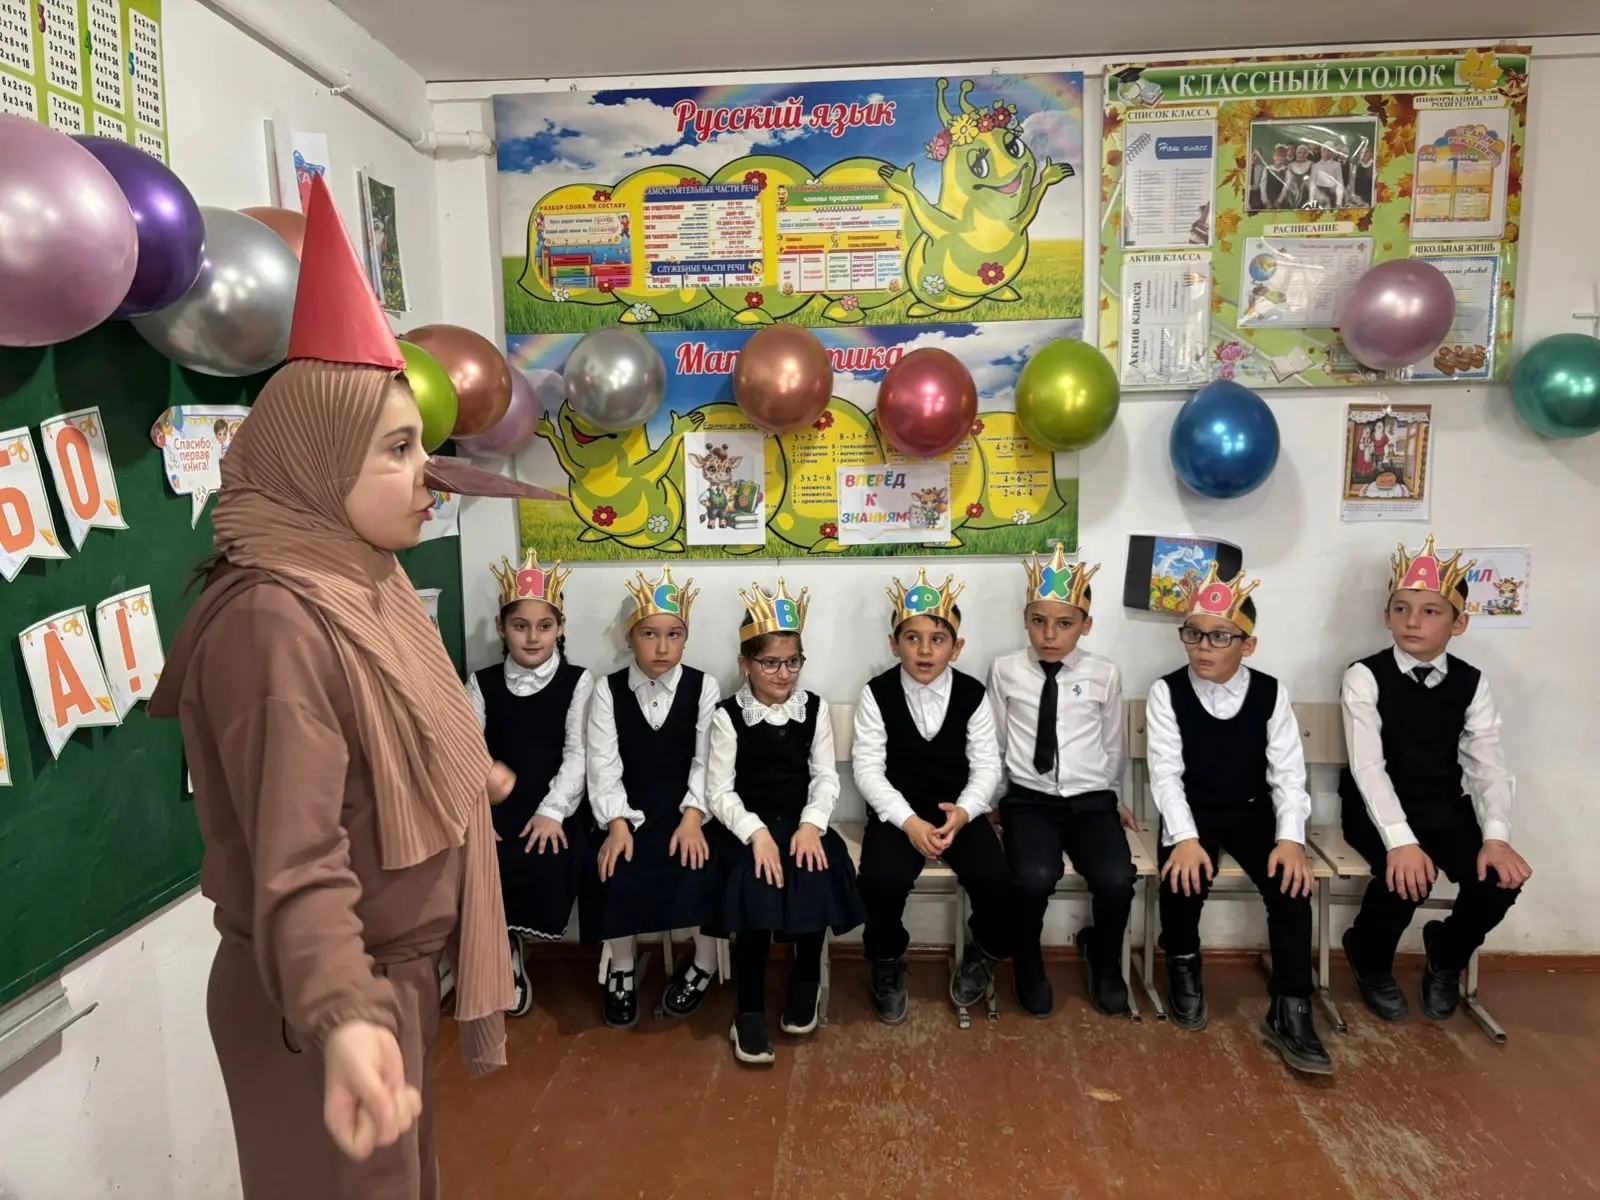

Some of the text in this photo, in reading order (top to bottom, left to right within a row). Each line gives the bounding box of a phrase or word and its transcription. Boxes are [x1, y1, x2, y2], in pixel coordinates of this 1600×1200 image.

[1179, 63, 1446, 97] КЛАССНЫЙ УГОЛОК
[672, 95, 897, 142] Русский язык
[1128, 109, 1211, 120] СПИСОК КЛАССА
[1158, 142, 1180, 152] Наш
[716, 184, 740, 193] ЧАСТИ
[741, 184, 759, 192] РЕЧИ
[829, 194, 879, 203] предложения
[1274, 224, 1338, 234] РАСПИСАНИЕ
[1415, 244, 1496, 254] ШКОЛЬНАЯ ЖИЗНЬ
[1129, 254, 1201, 263] АКТИВ КЛАССА
[657, 265, 700, 273] СЛУЖЕБНЫЕ
[701, 264, 726, 272] ЧАСТИ
[1129, 282, 1142, 368] Актив класса
[174, 438, 214, 451] Спасибо,
[180, 451, 210, 461] первая
[183, 461, 209, 472] книга!
[845, 471, 906, 489] ВПЕРЁД
[865, 493, 878, 506] К
[1403, 556, 1441, 592] А
[516, 569, 545, 598] Я
[1039, 567, 1073, 599] Х
[654, 584, 680, 614] С
[775, 599, 799, 630] В
